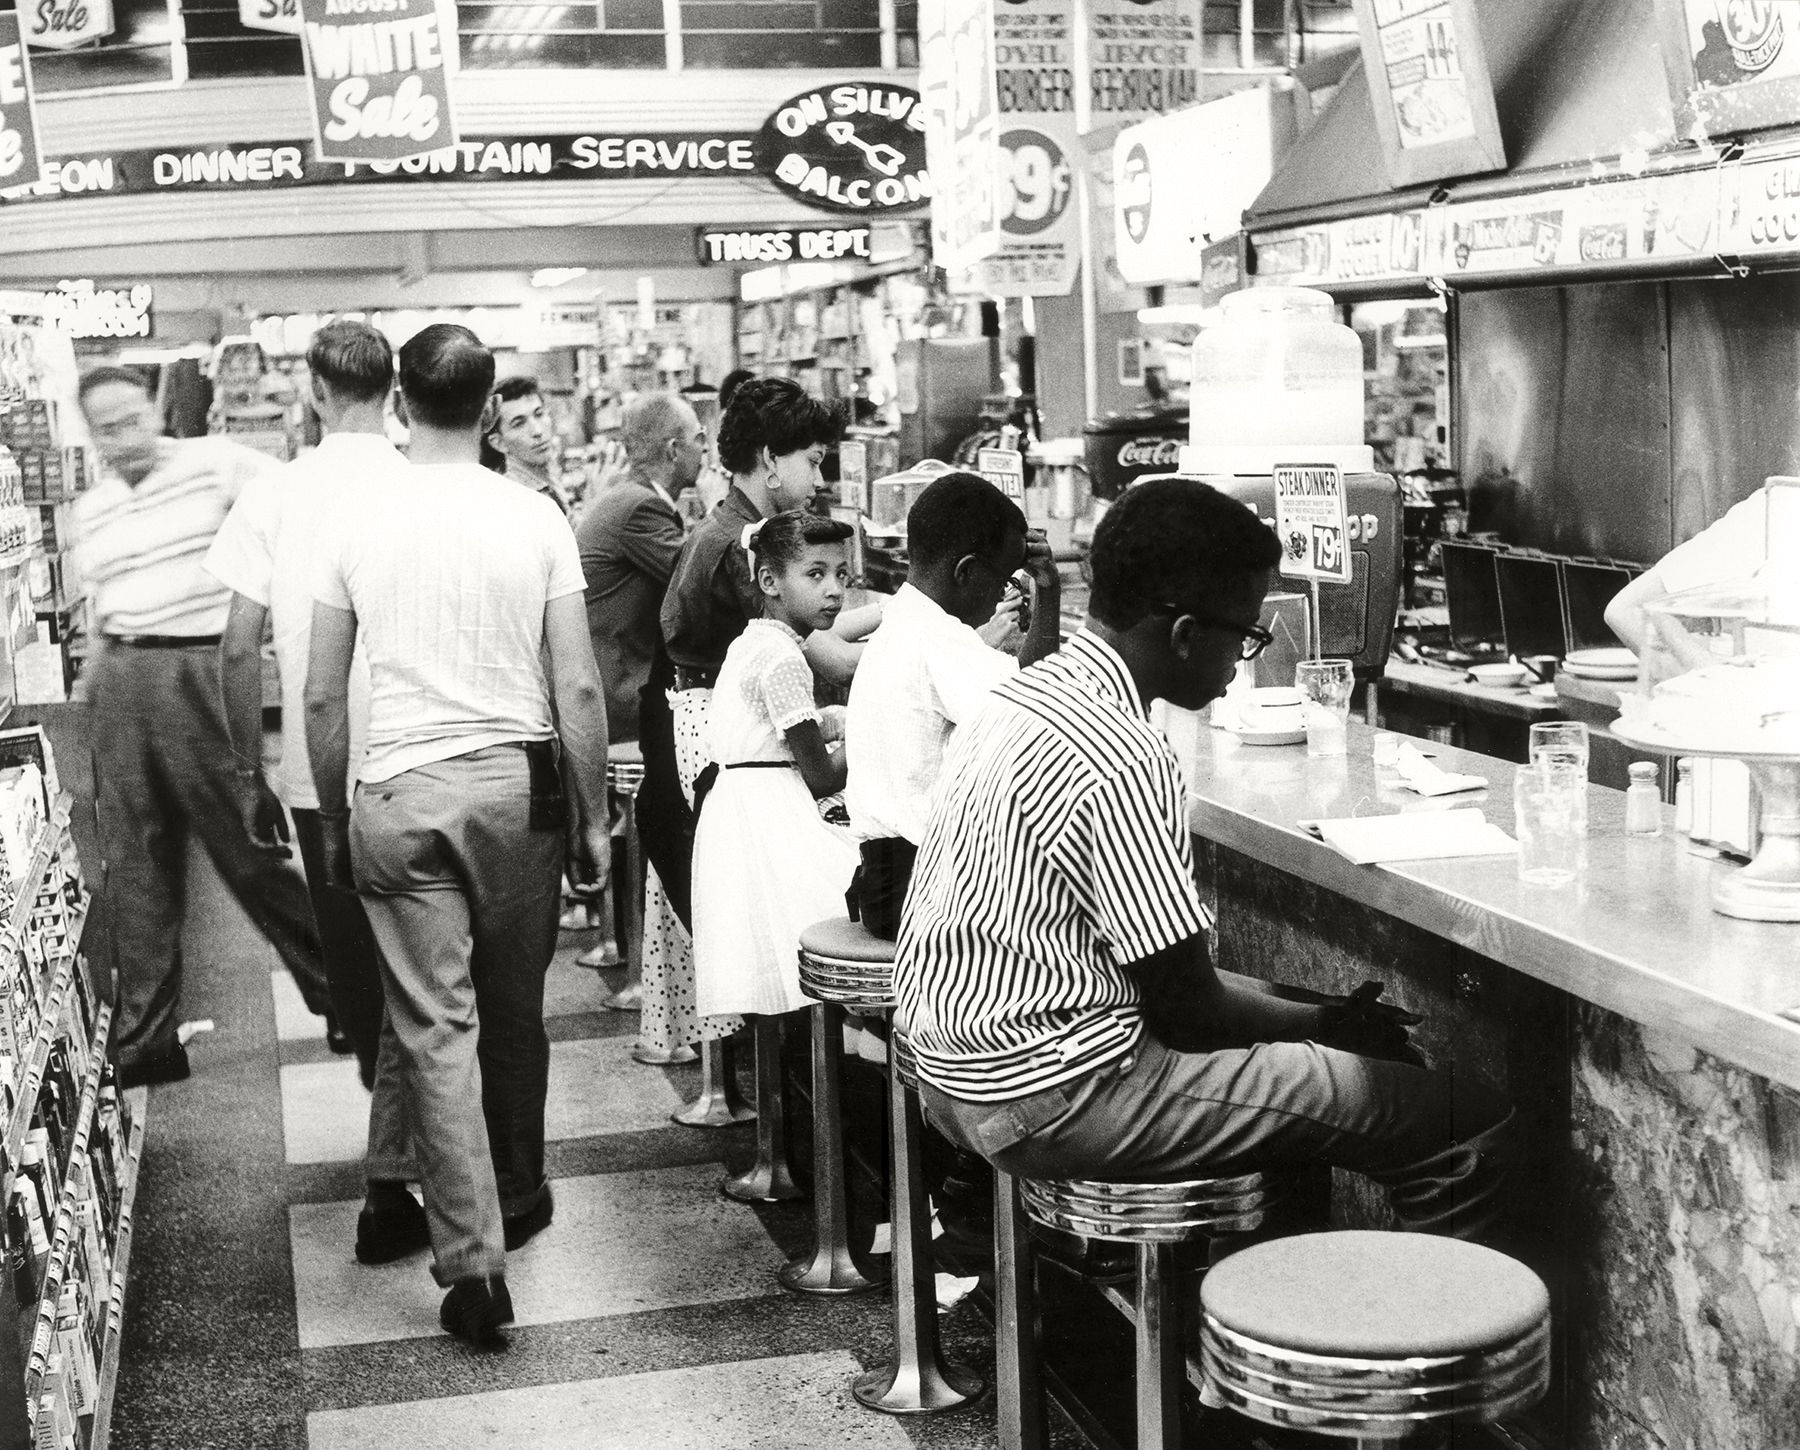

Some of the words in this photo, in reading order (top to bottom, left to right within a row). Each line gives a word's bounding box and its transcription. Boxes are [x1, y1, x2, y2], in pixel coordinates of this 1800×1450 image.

[31, 0, 88, 34] Sale
[304, 12, 443, 80] WHITE
[324, 75, 440, 142] Sale
[776, 93, 828, 137] ON
[153, 147, 303, 186] DINNER
[571, 136, 755, 169] SERVICE
[704, 231, 792, 261] TRUSS
[1278, 471, 1305, 497] STEAK
[1305, 471, 1338, 496] DINNER
[1313, 527, 1342, 568] 79¢
[73, 1379, 85, 1410] Vaseline
